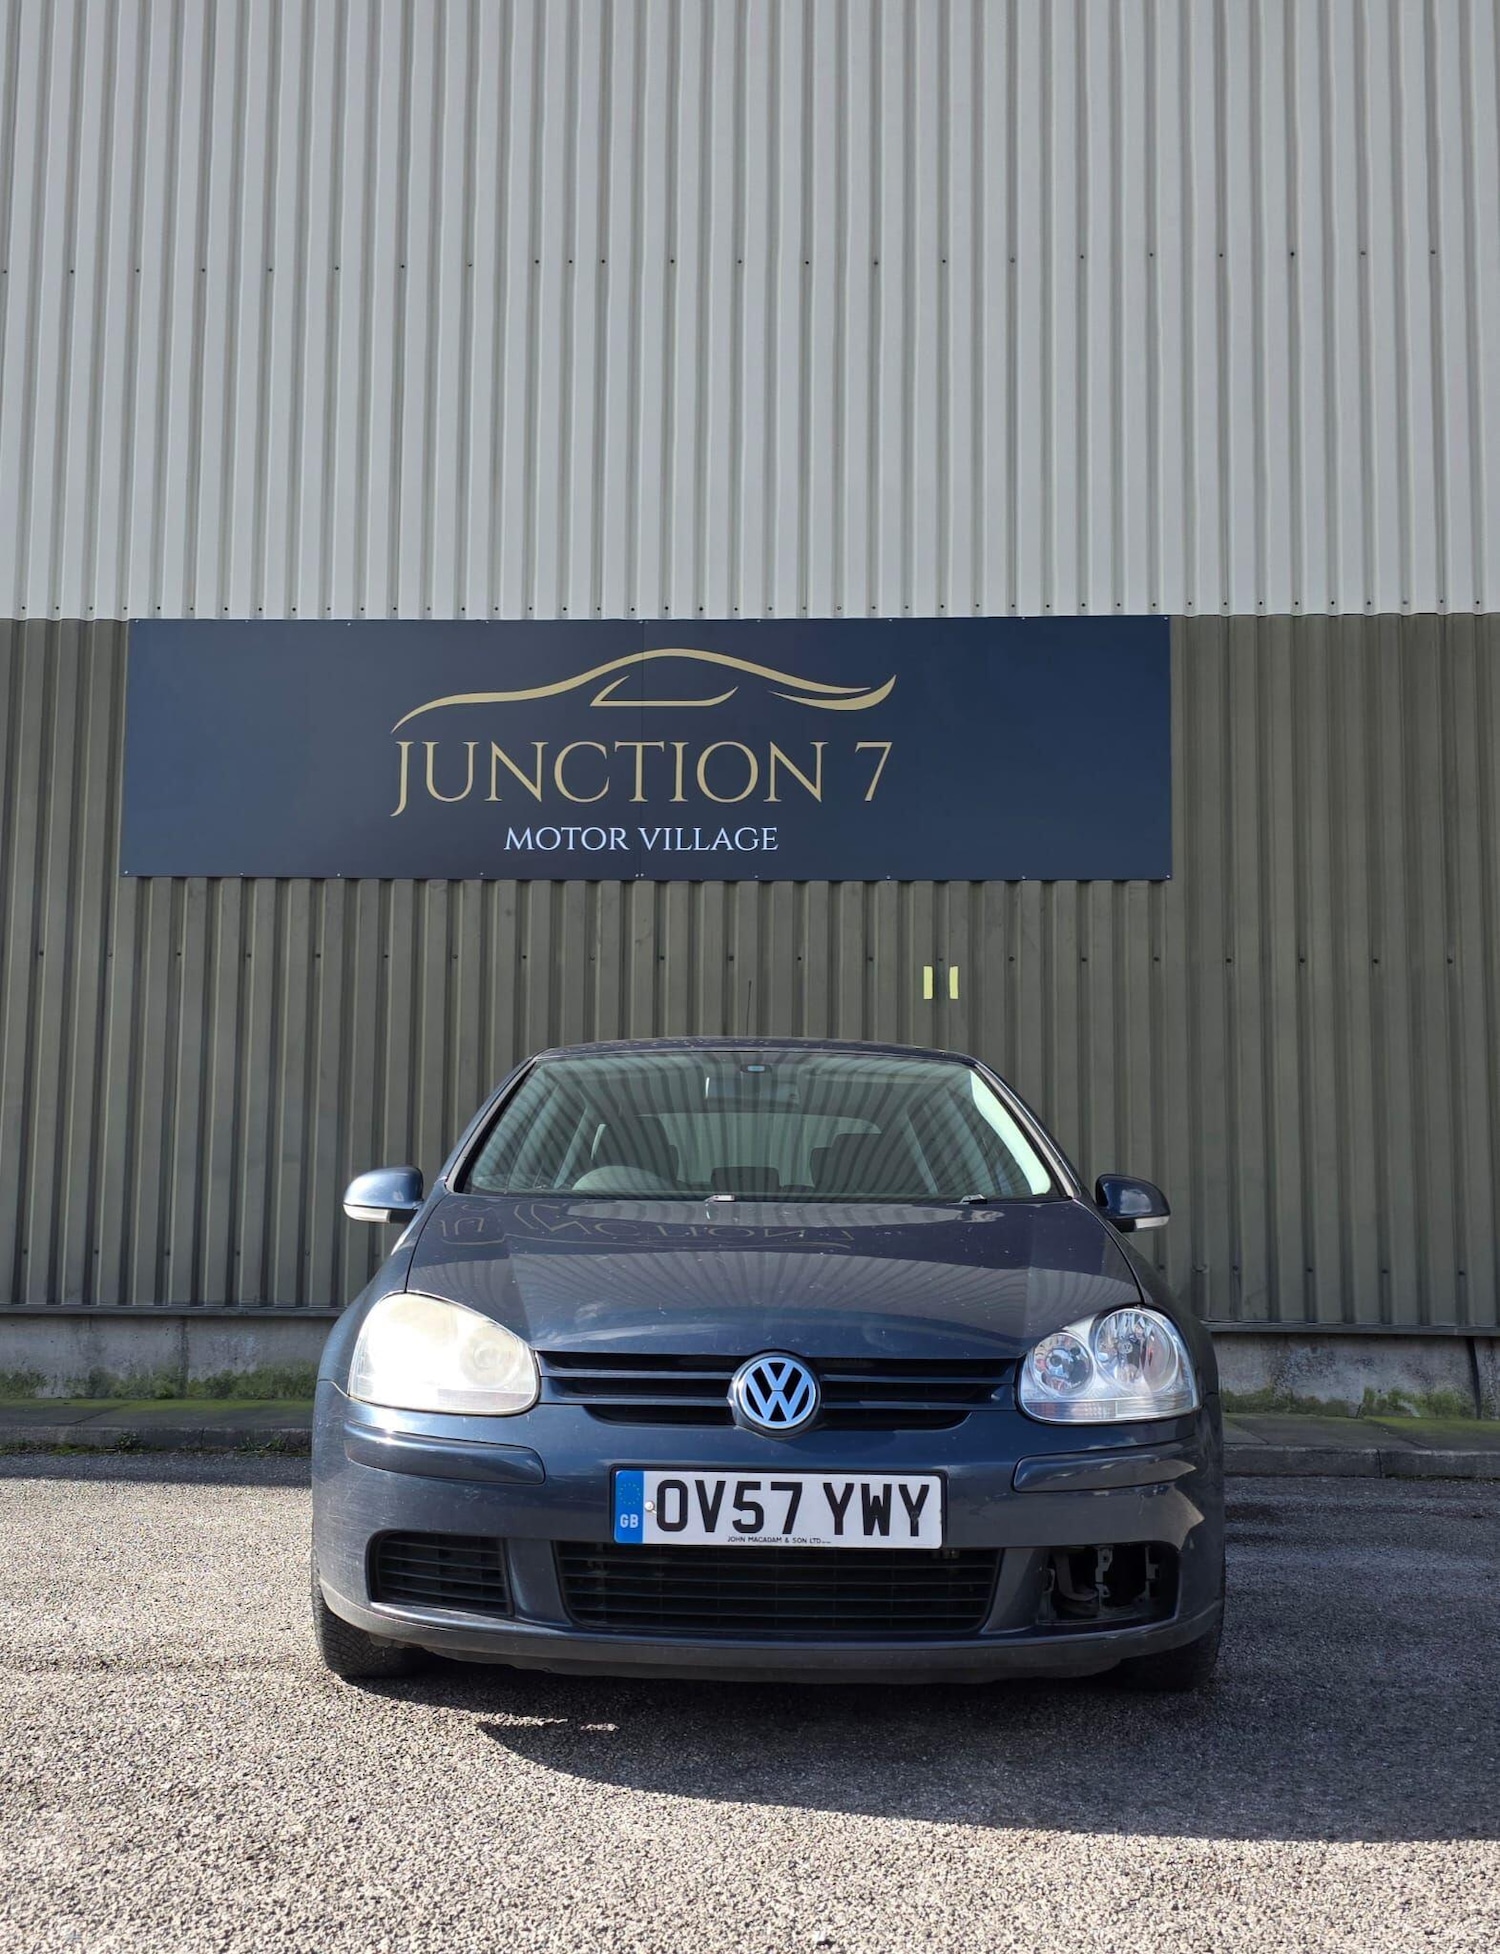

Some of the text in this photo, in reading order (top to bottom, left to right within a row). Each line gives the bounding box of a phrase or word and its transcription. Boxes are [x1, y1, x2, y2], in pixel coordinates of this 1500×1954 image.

[390, 740, 893, 817] JUNCTION 7
[503, 827, 778, 852] MOTOR VILLAGE
[656, 1479, 930, 1537] OV57 YWY
[619, 1513, 639, 1529] GB
[747, 1536, 783, 1544] MACADAM
